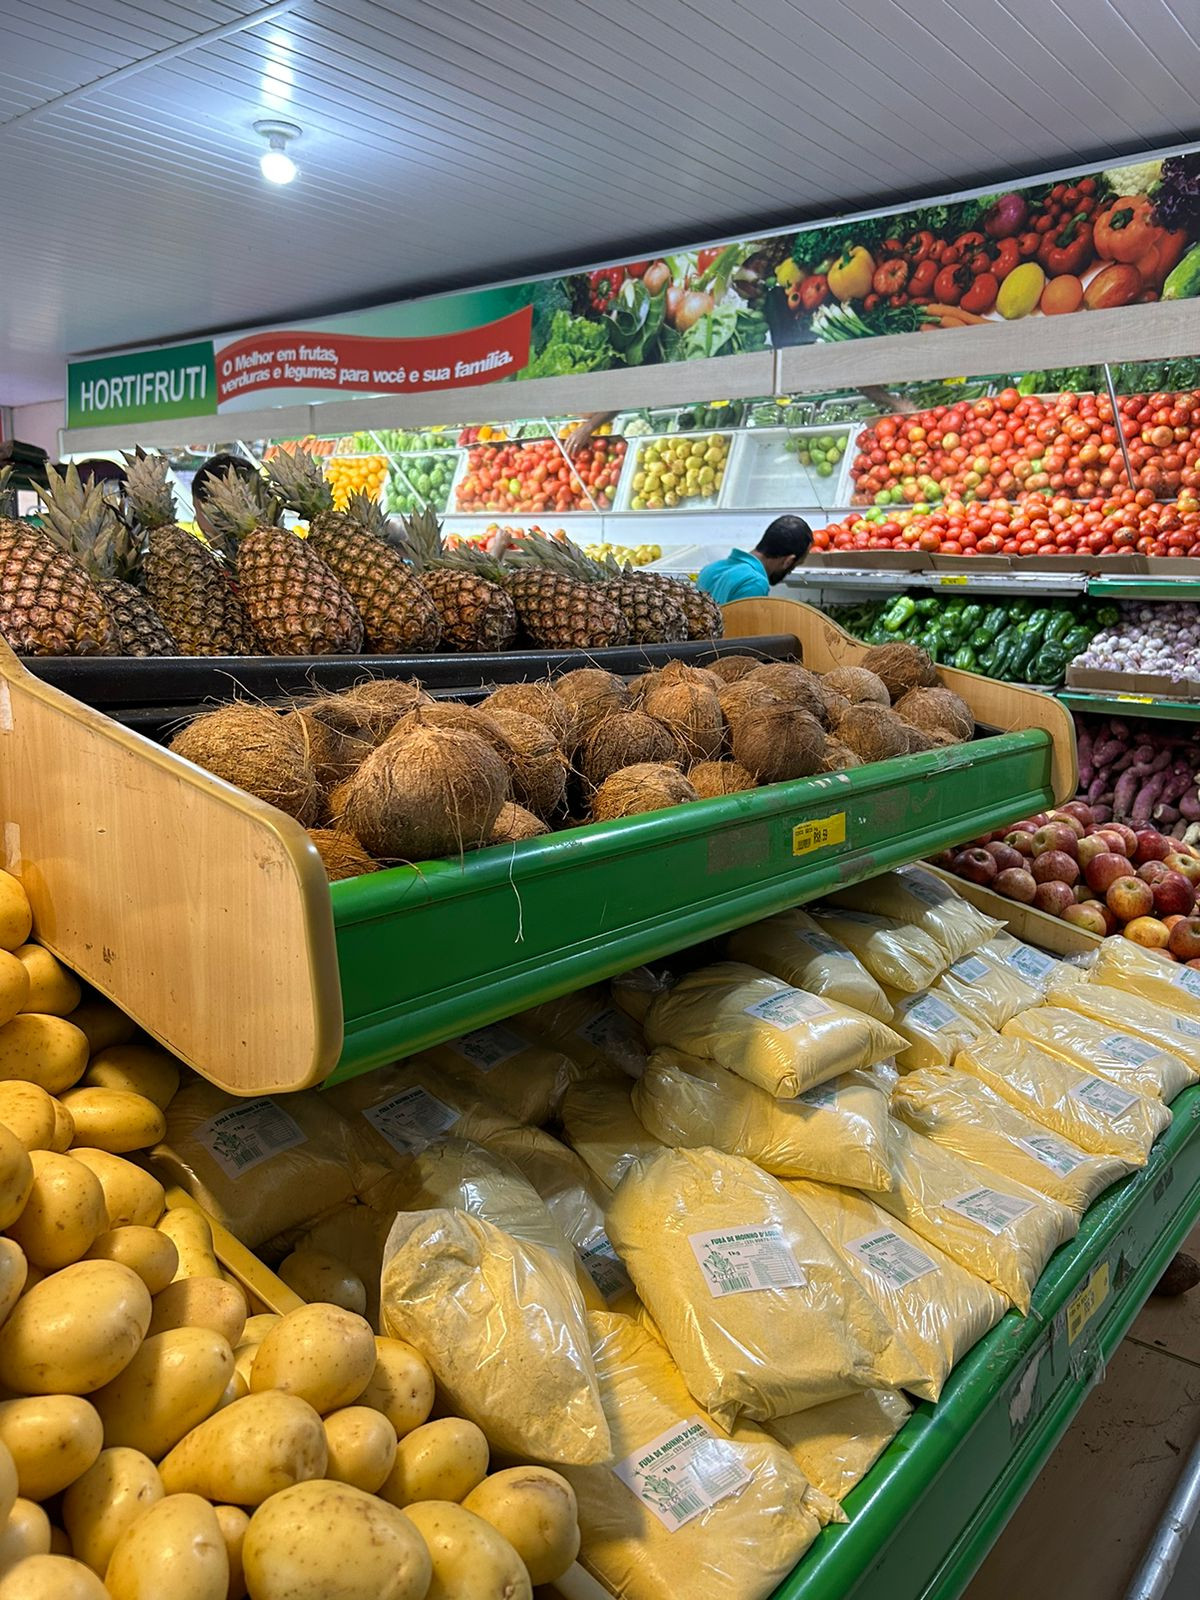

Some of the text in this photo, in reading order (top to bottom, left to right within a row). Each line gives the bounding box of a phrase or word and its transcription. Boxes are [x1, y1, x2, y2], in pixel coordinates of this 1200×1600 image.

[222, 345, 339, 376] O Melhor em frutas,
[222, 349, 514, 394] verduras e legumes para você e sua família.
[81, 365, 207, 412] HORTIFRUTI
[638, 1454, 655, 1469] FUBÁ
[654, 1449, 663, 1459] DE
[661, 1435, 684, 1455] MOINHO
